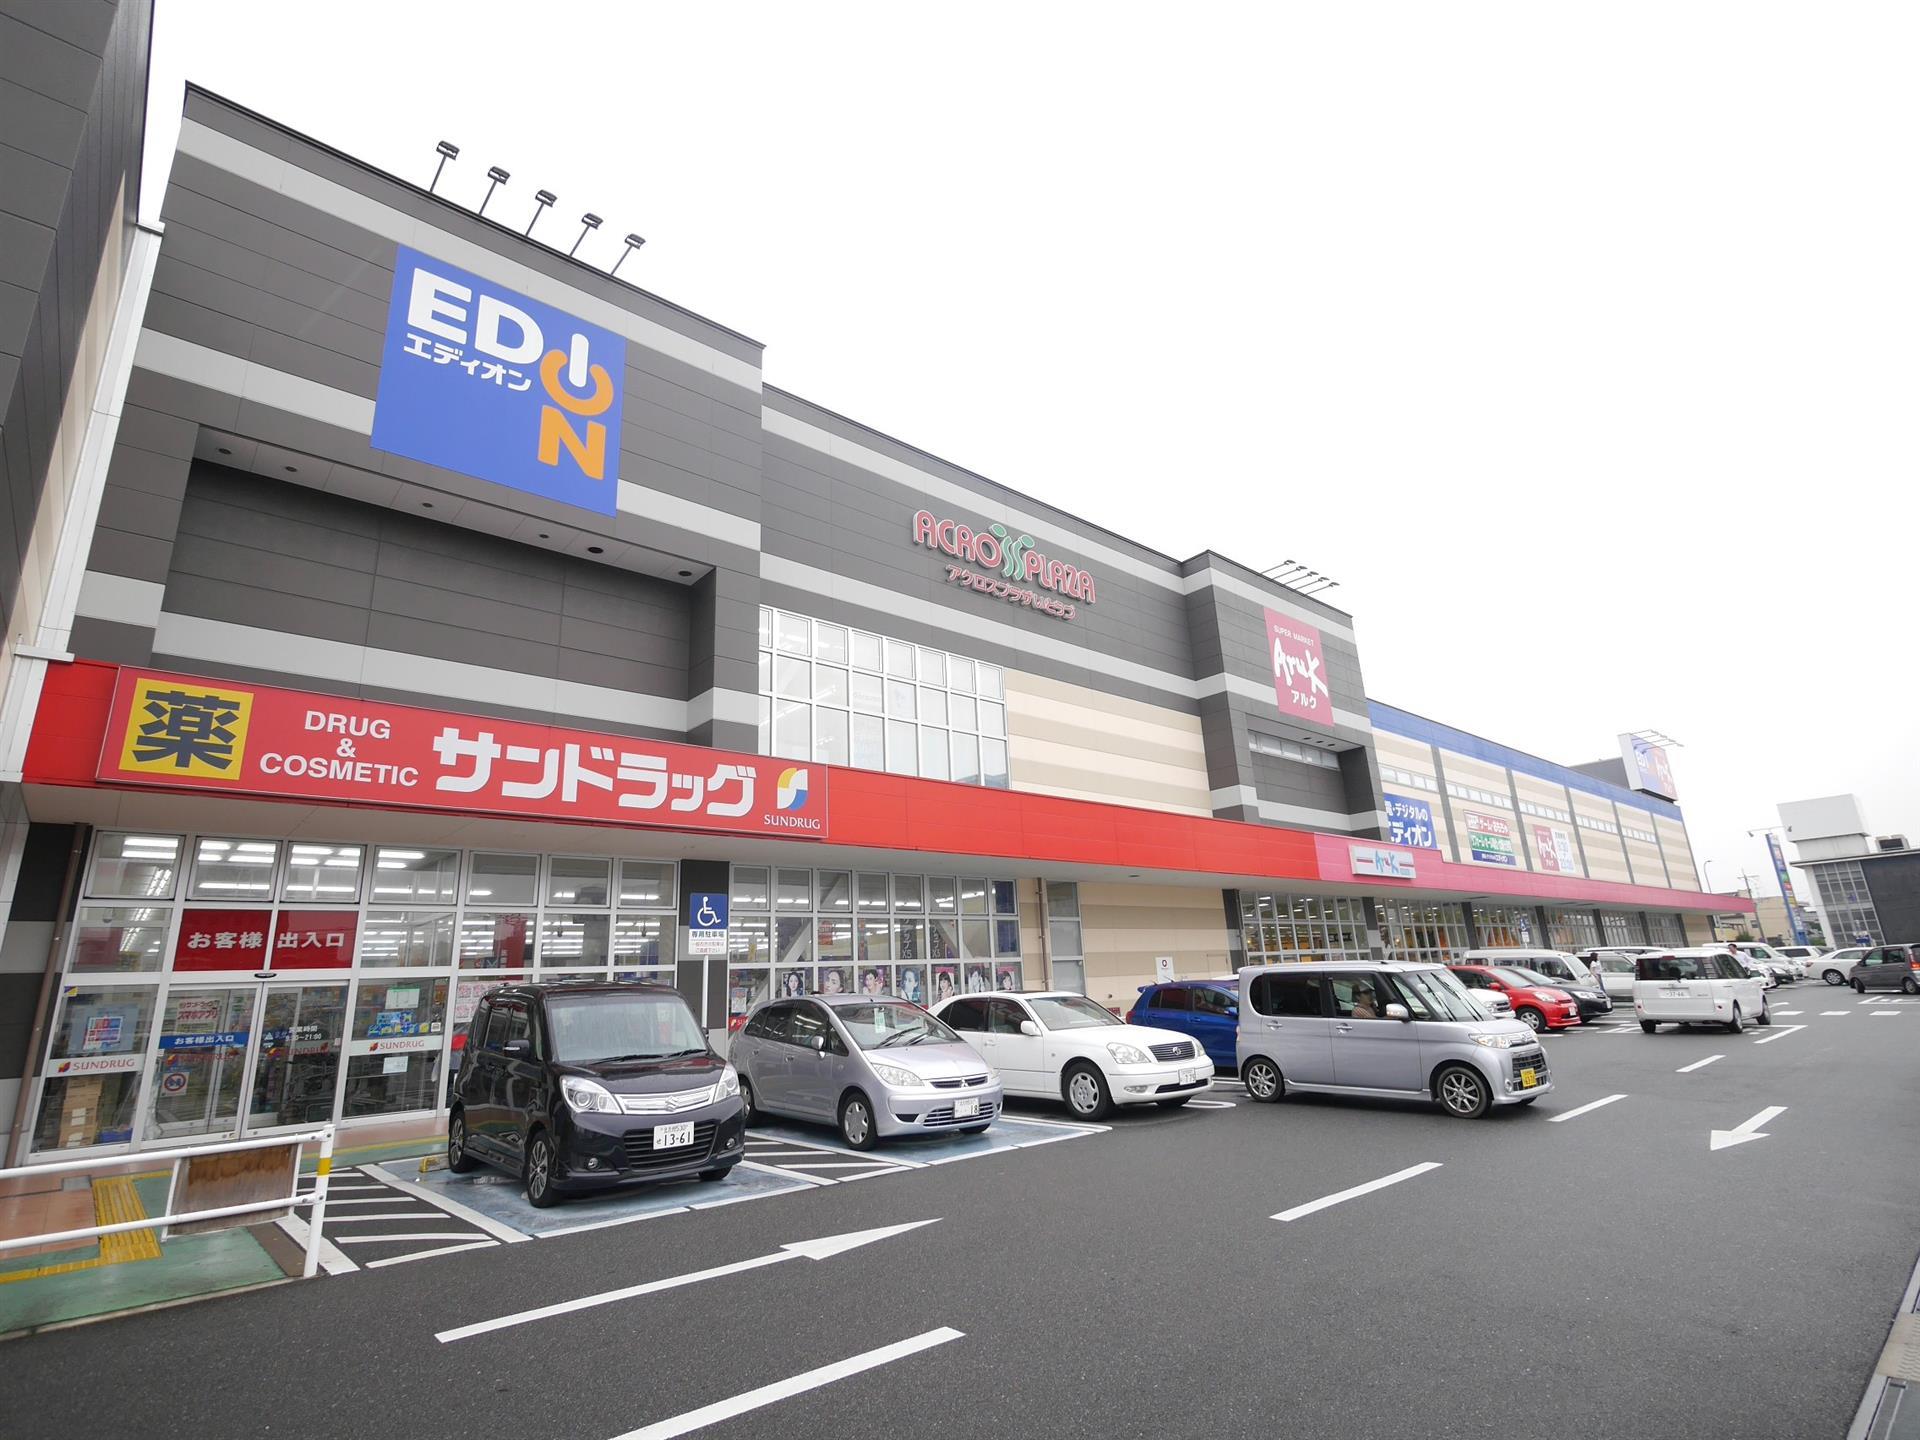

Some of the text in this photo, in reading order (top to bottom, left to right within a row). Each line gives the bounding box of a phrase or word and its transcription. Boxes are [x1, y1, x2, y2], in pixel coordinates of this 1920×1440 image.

[403, 332, 532, 392] エディオン
[912, 509, 1097, 605] ACROSS PLAZA
[1272, 624, 1315, 647] SUPER MARKET
[1290, 688, 1317, 709] アルク
[132, 689, 241, 770] 薬
[304, 709, 392, 740] DRUG
[335, 737, 357, 759] &
[259, 751, 420, 788] COSMETIC
[432, 726, 758, 818] サンドラッグ
[764, 813, 822, 831] SUNDRUG
[187, 931, 345, 950] お客様 出入口
[691, 930, 725, 938] 専用駐車場
[174, 1034, 235, 1045] お客様出入口
[379, 1040, 425, 1050] SUNDRUG
[73, 1058, 135, 1071] SUNDRUG
